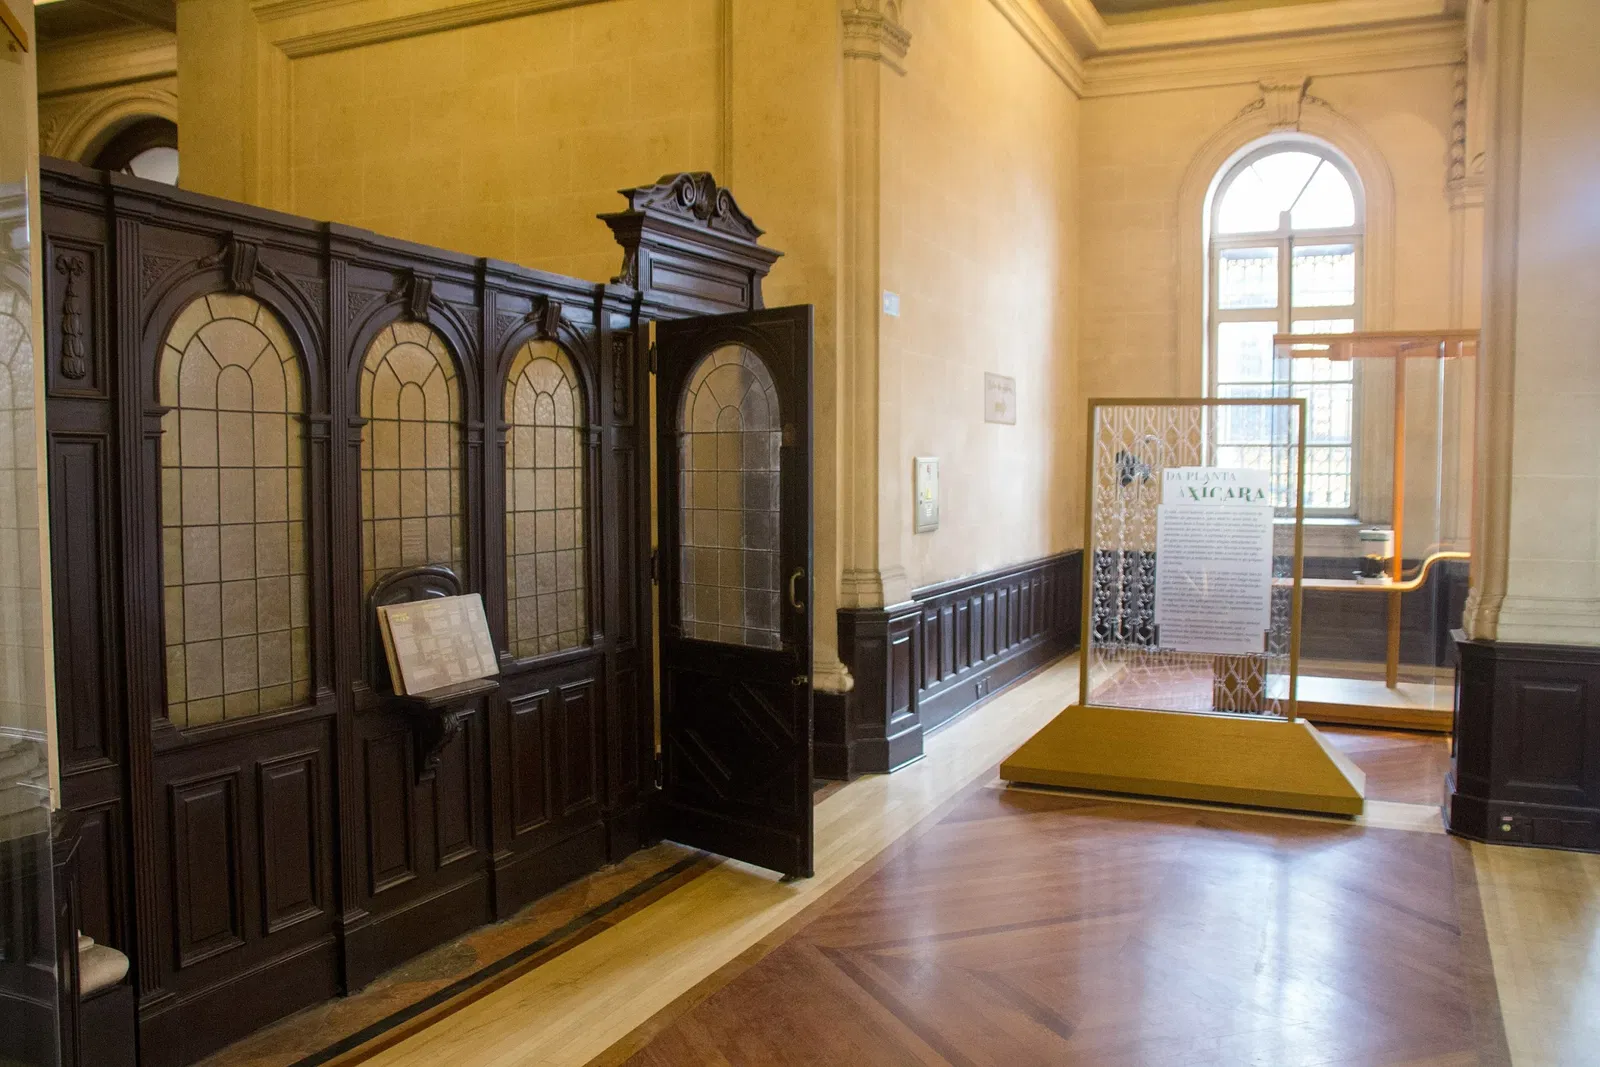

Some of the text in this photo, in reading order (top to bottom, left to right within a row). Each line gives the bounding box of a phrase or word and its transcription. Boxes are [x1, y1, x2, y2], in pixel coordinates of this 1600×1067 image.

[1166, 471, 1237, 481] DA PLANTA
[1187, 481, 1265, 502] XÍCARA
